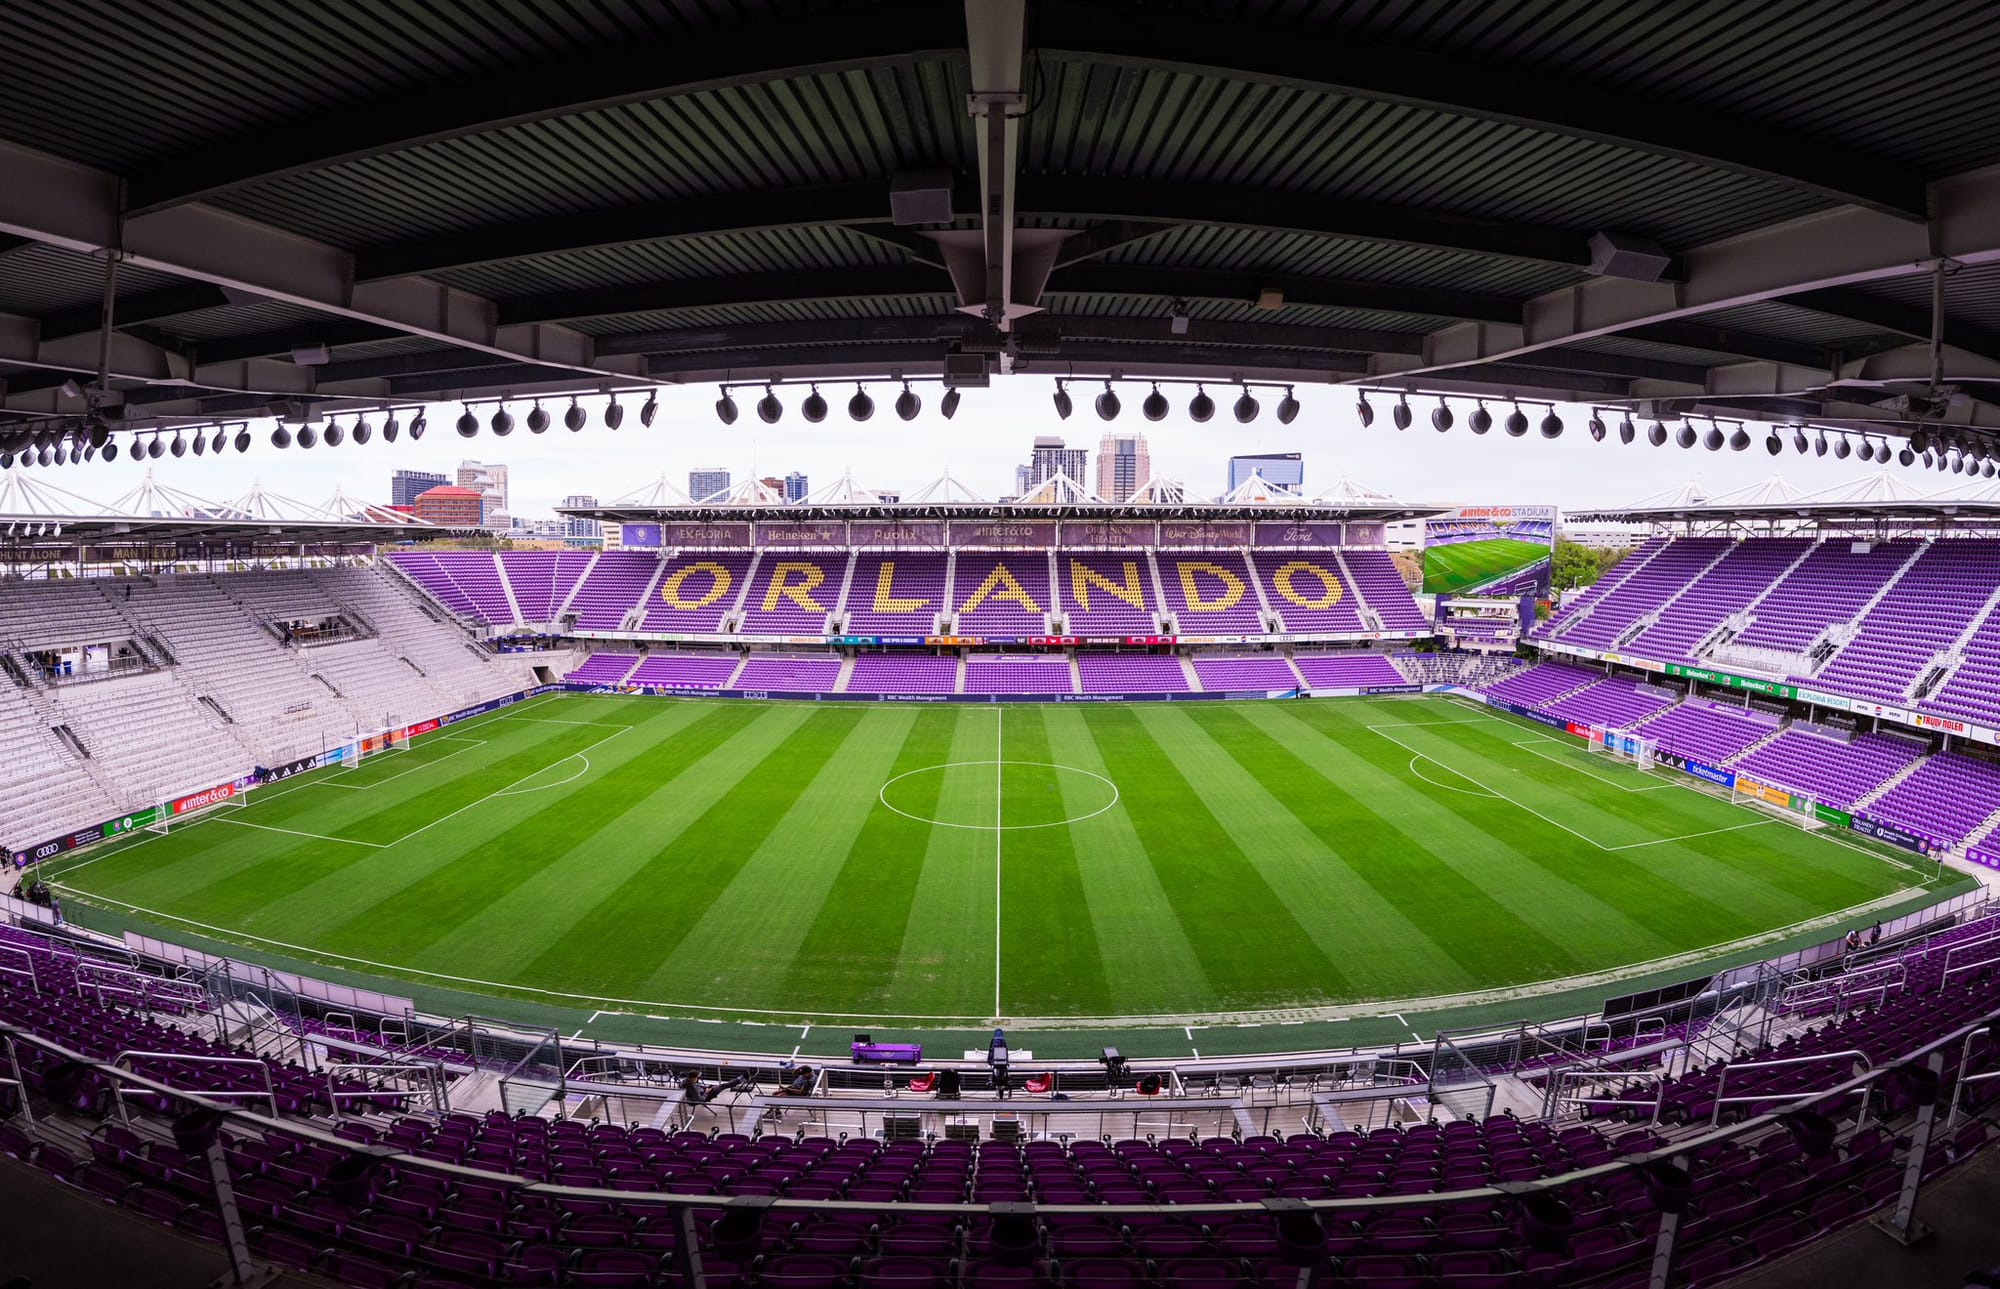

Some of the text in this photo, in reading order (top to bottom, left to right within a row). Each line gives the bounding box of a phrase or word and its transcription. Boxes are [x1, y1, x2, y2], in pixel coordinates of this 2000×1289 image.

[1511, 508, 1549, 517] STADIUM
[768, 529, 817, 540] Heineken
[1085, 526, 1132, 534] ORLANDO
[1219, 527, 1244, 538] World
[1283, 527, 1313, 541] Ford
[1090, 535, 1126, 543] HEALTH
[0, 549, 62, 560] HUNT ALONE
[112, 548, 138, 558] MAN
[142, 548, 159, 558] THE
[660, 559, 1344, 613] ORLANDO
[1394, 685, 1421, 693] Management
[916, 694, 947, 702] Management
[1827, 697, 1848, 708] RESORTS
[1922, 715, 1963, 732] TRULY NOLEN
[1692, 764, 1728, 783] ticketmaster
[1852, 817, 1874, 829] ORLANDO
[1853, 823, 1871, 834] HEALTH
